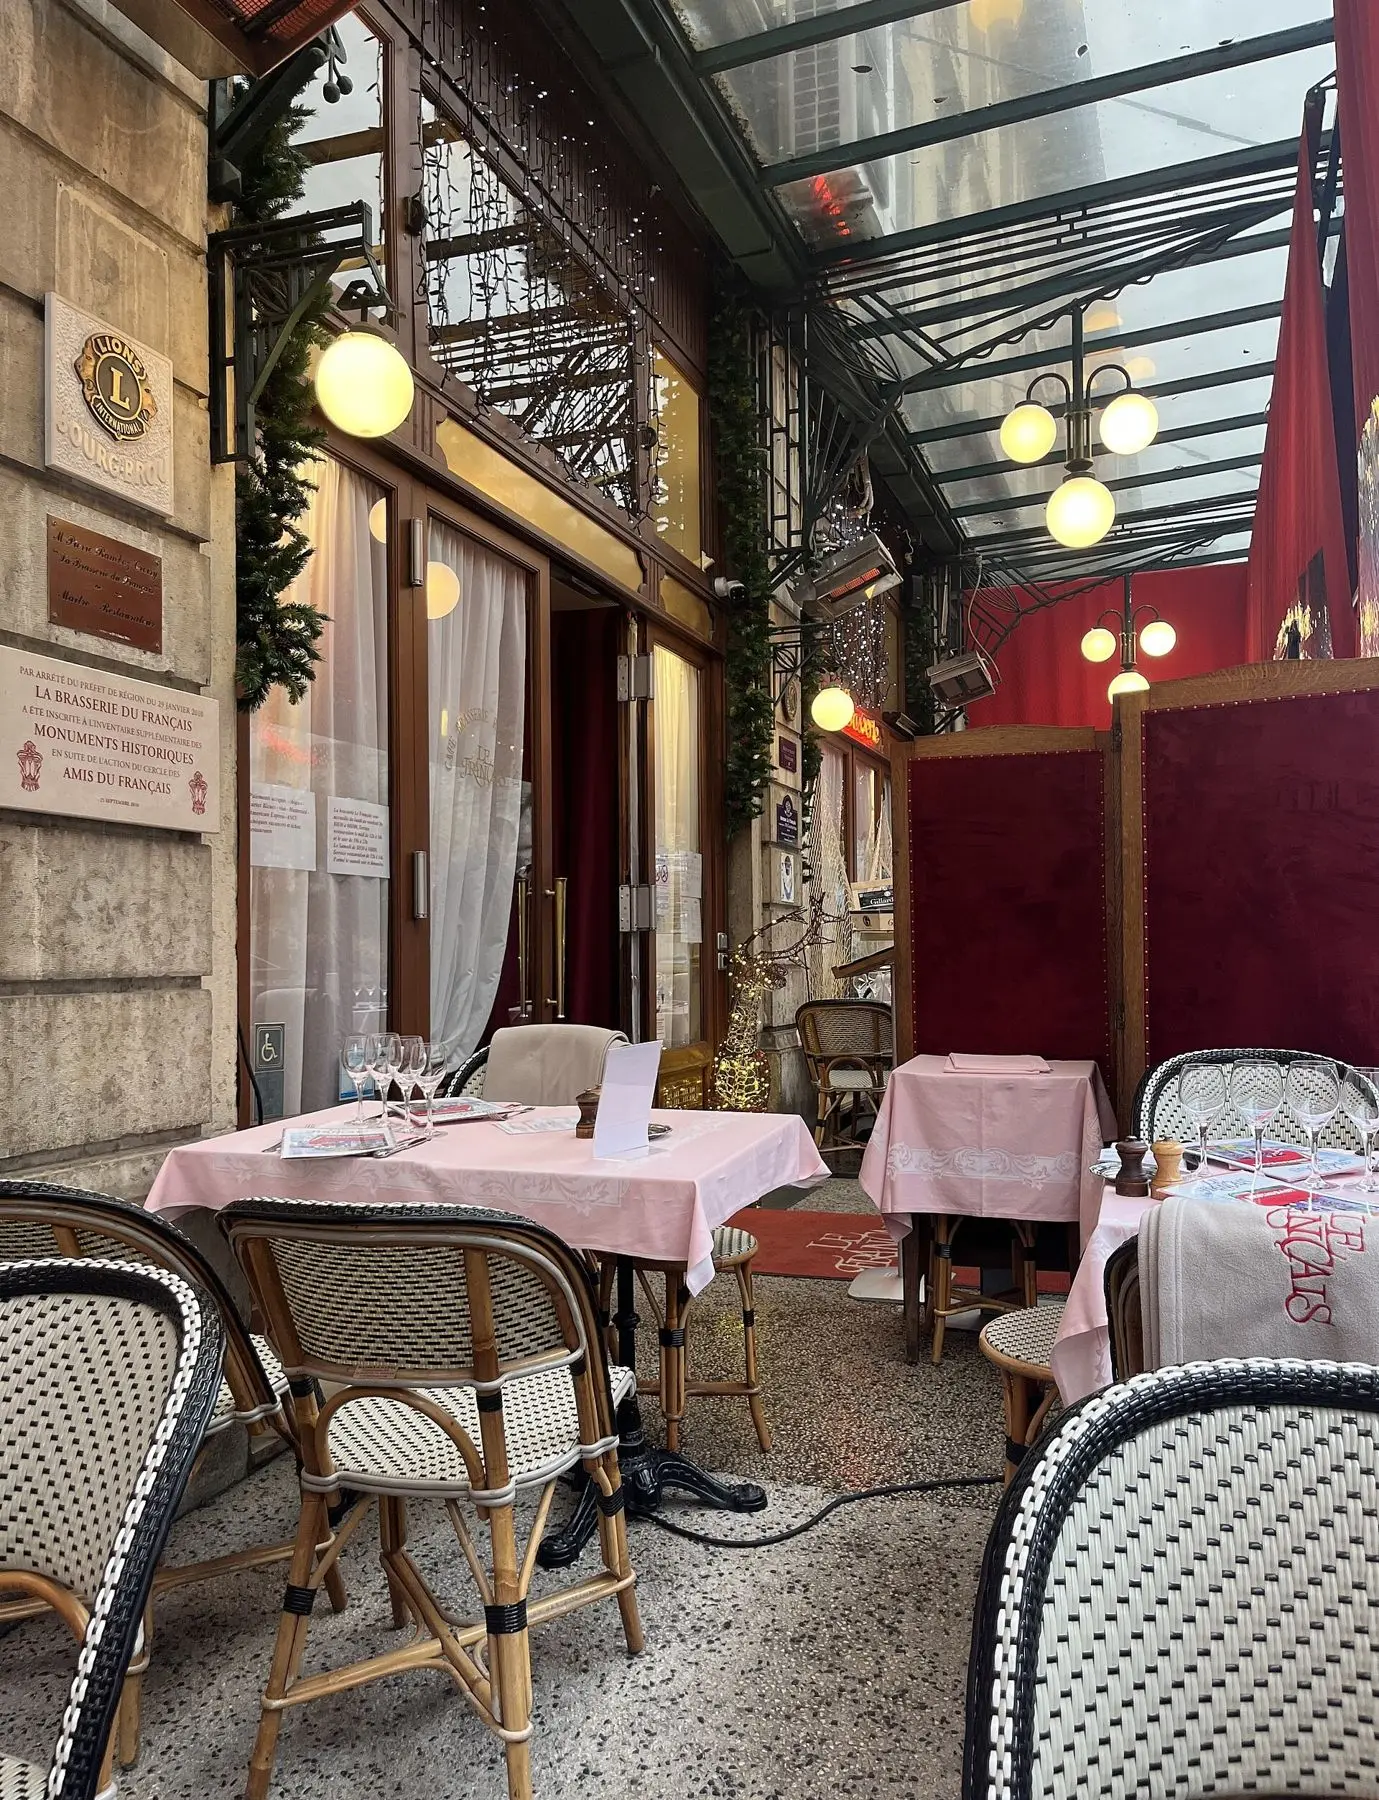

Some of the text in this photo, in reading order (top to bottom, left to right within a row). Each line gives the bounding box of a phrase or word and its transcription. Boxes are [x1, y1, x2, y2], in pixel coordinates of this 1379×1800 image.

[97, 336, 143, 374] LIONS
[109, 366, 130, 412] L
[96, 401, 143, 435] INTERNATIONAL
[20, 665, 33, 677] PAR
[35, 668, 64, 684] ARRÊTÉ
[67, 677, 78, 688] DU
[80, 679, 105, 694] PRÉFET
[108, 687, 116, 697] DE
[118, 689, 144, 703] RÉGION
[146, 697, 156, 706] DU
[165, 701, 190, 715] JANVIER
[35, 685, 191, 735] LA BRASSERIE DU FRANÇAIS
[22, 704, 27, 713] A
[29, 704, 43, 716] ÉTÉ
[46, 709, 80, 724] INSCRITE
[82, 716, 87, 725] À
[136, 728, 189, 747] SUPPLÉMENTAIRE
[191, 741, 201, 749] DES
[33, 722, 193, 767] MONUMENTS HISTORIQUES
[51, 748, 62, 757] EN
[64, 750, 84, 761] SUITE
[87, 754, 97, 763] DE
[132, 763, 142, 771] DU
[143, 765, 167, 776] CERCLE
[168, 769, 179, 778] DES
[63, 766, 170, 797] AMIS DU FRANÇAIS
